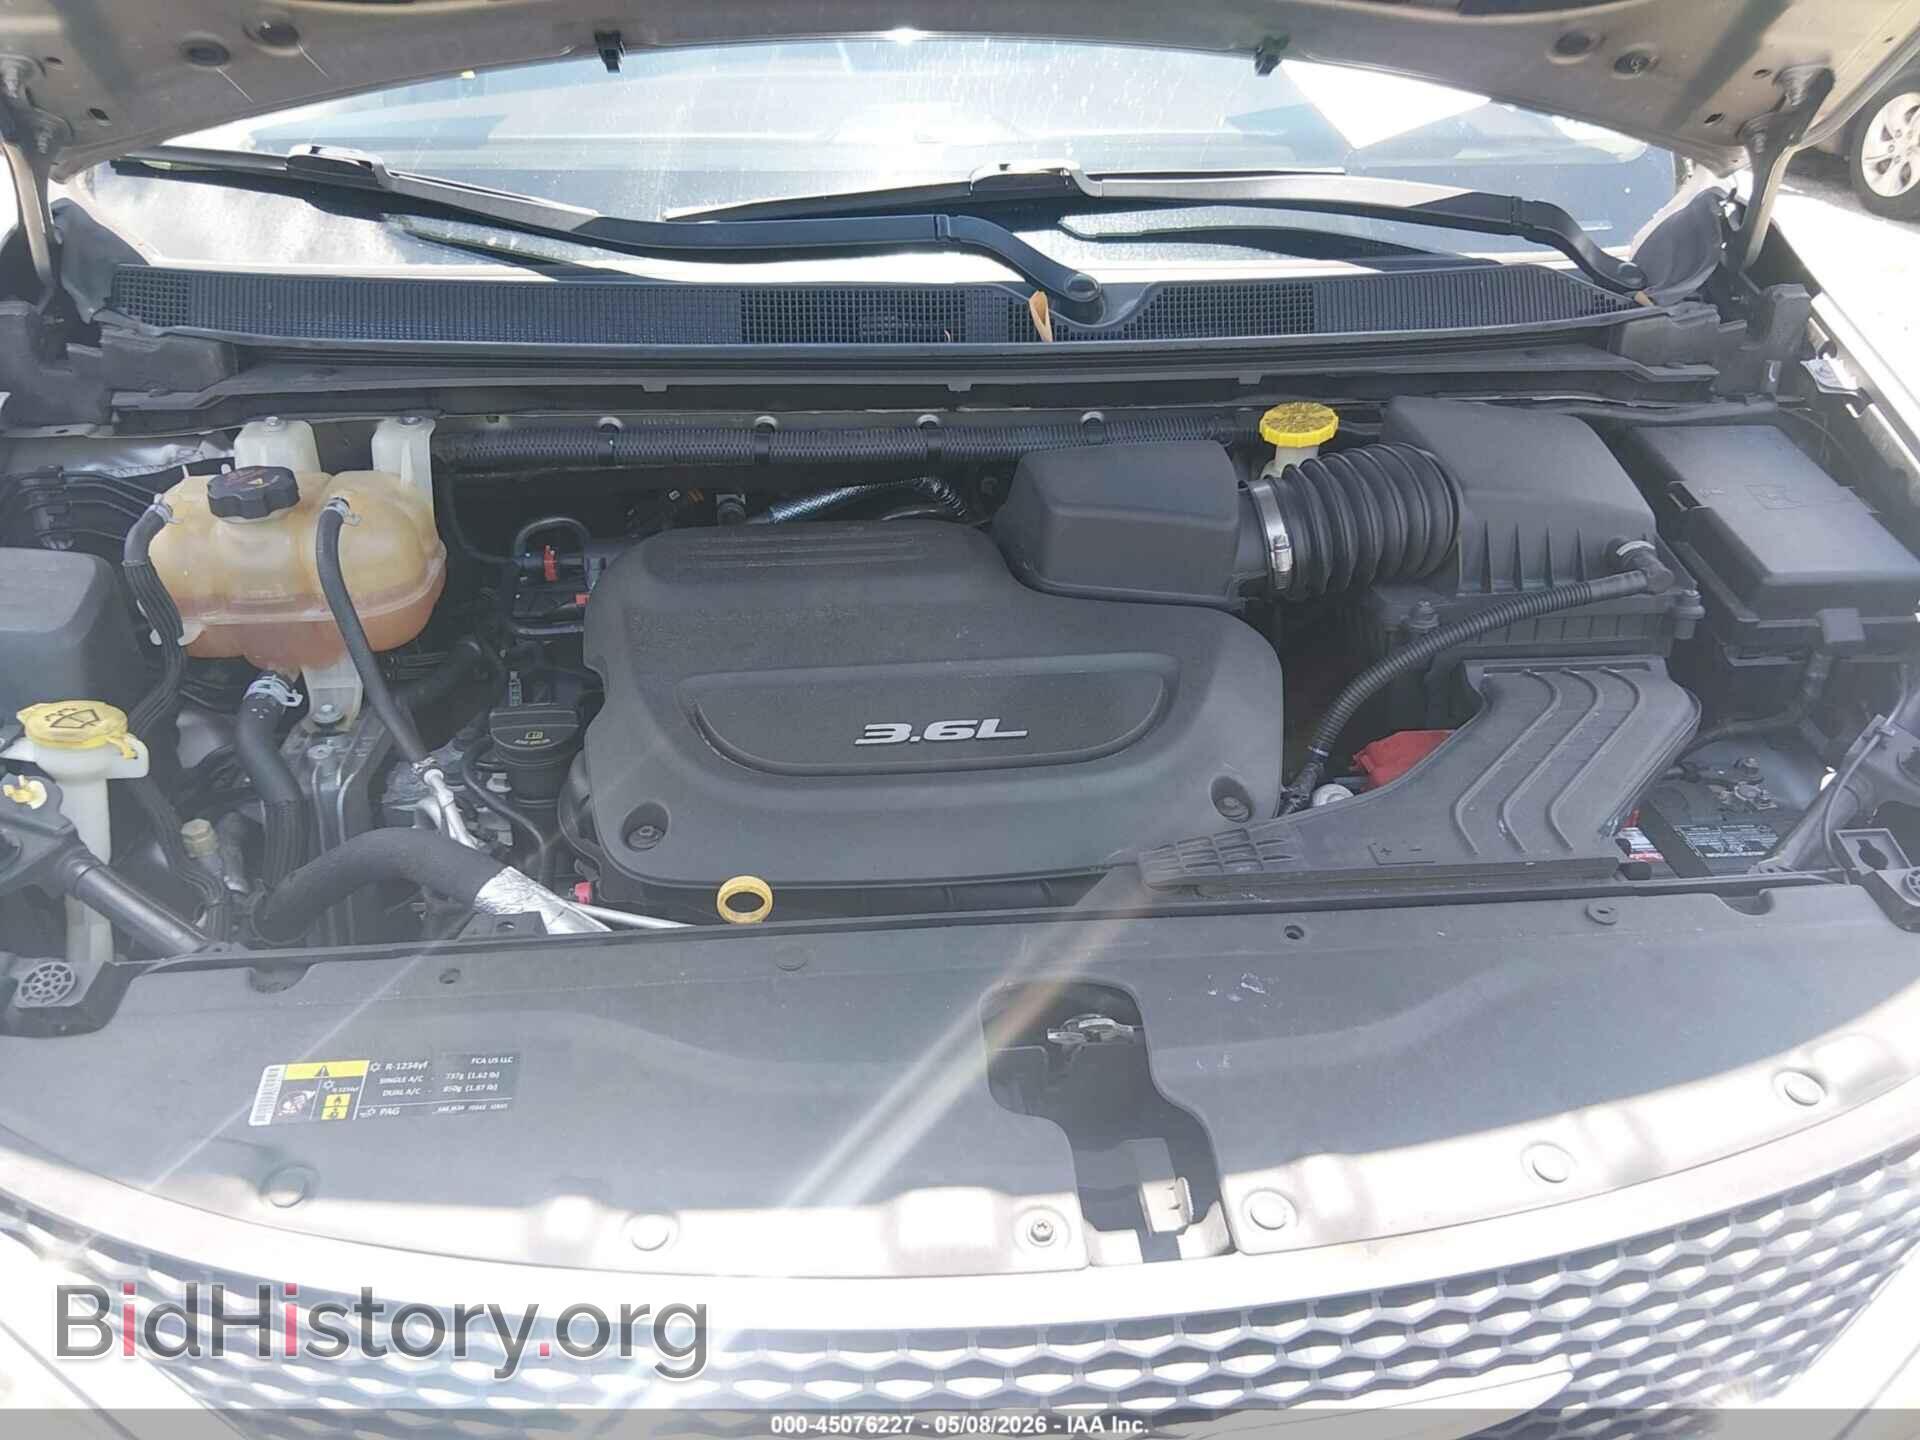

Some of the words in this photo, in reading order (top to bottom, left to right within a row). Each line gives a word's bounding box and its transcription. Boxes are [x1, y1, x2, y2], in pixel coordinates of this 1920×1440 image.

[855, 719, 1028, 745] 3.6L
[471, 1057, 486, 1065] FCA
[500, 1056, 514, 1064] LLC
[385, 1060, 429, 1072] R-1234yf
[406, 1087, 421, 1096] A/C
[379, 1107, 401, 1117] PAG
